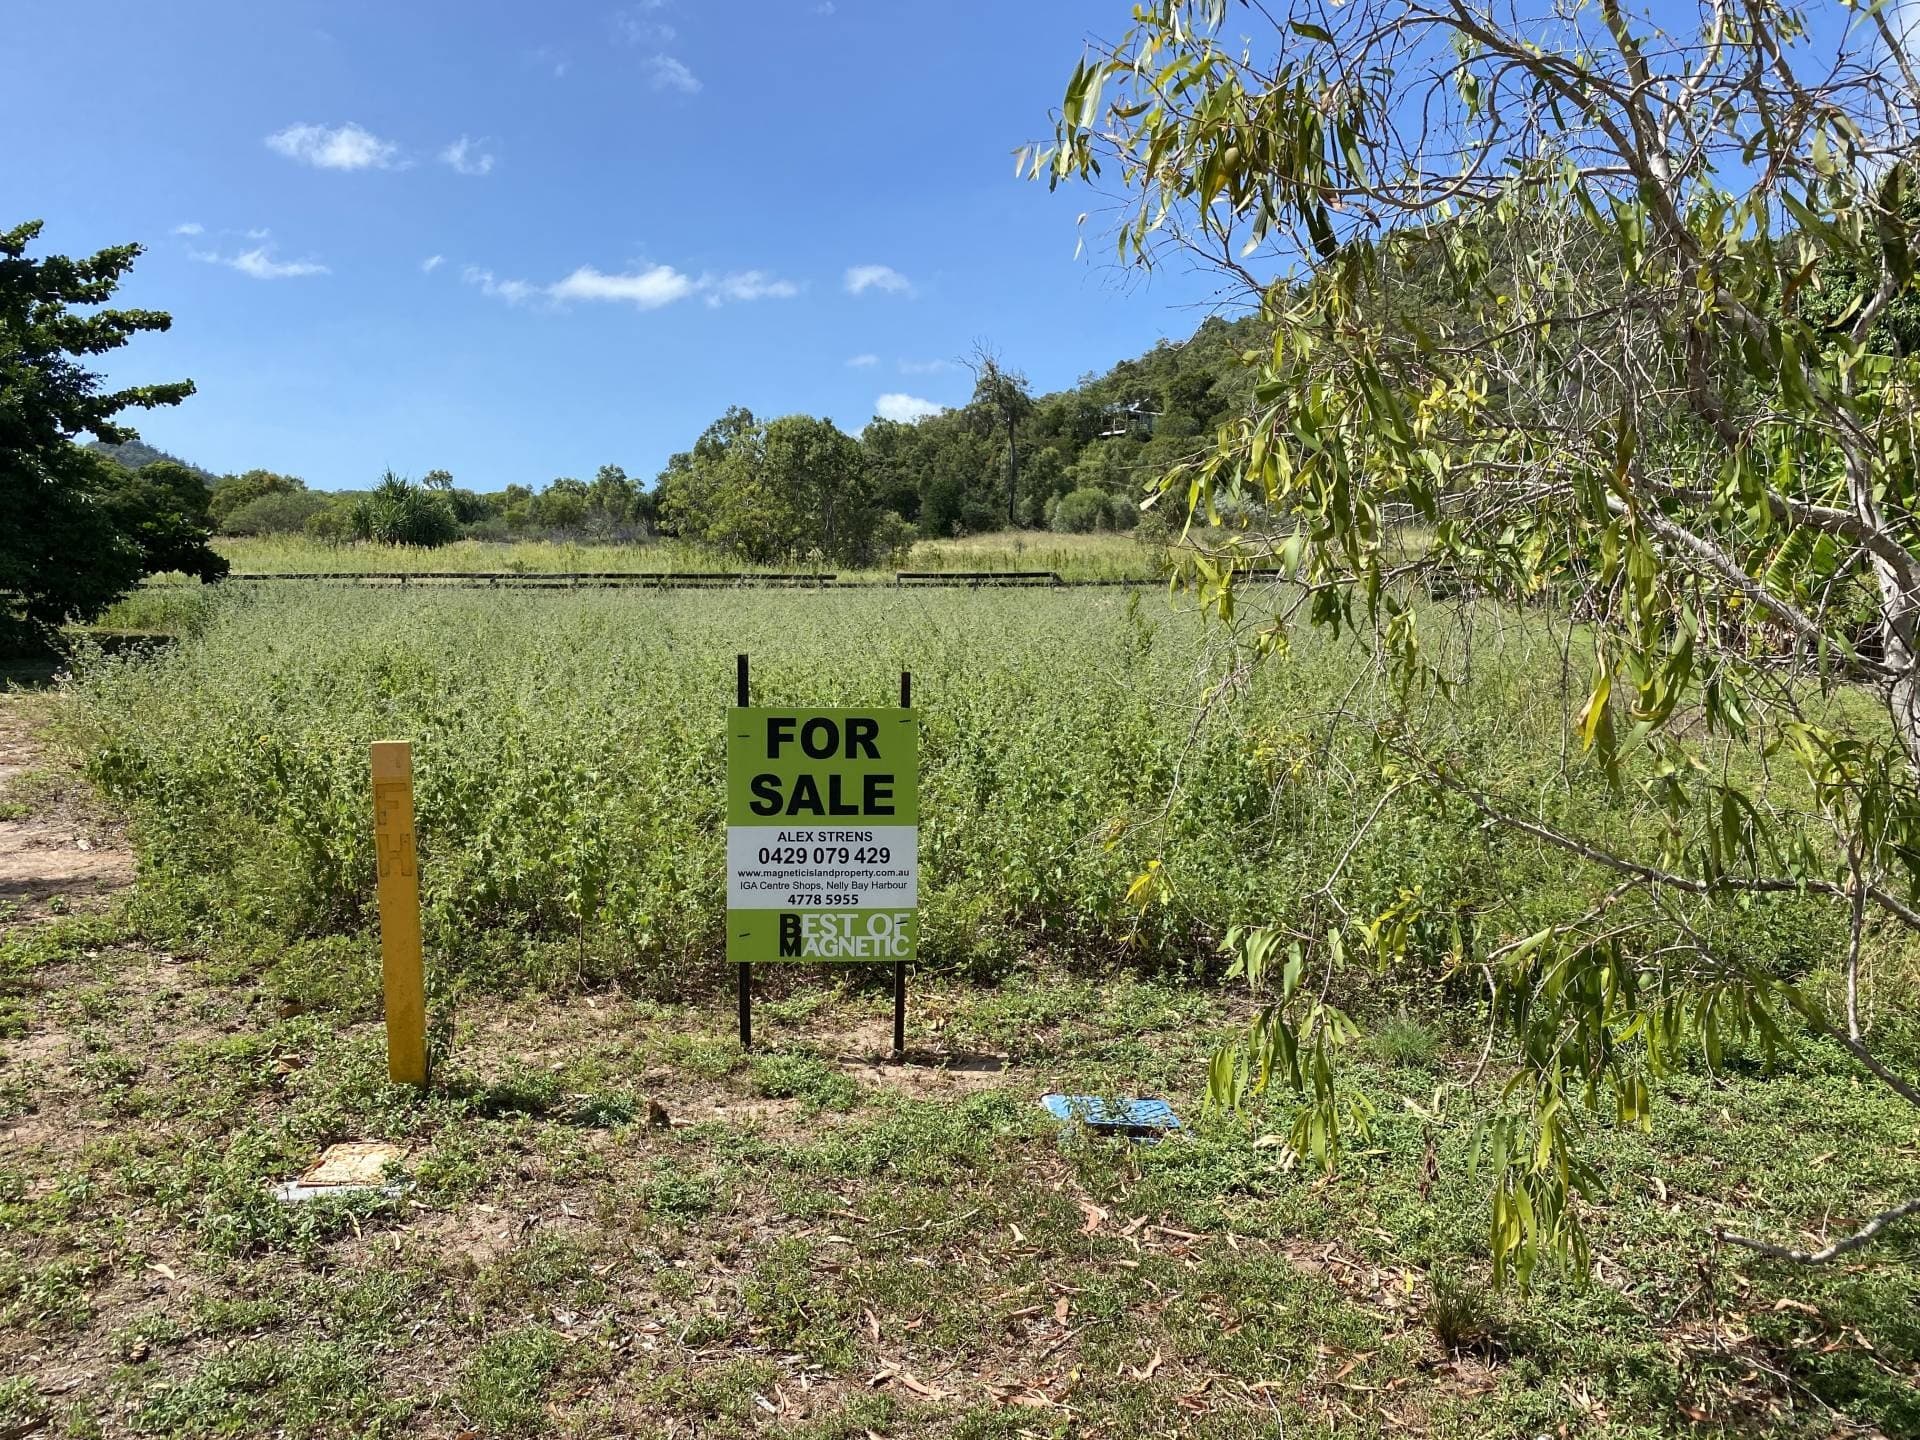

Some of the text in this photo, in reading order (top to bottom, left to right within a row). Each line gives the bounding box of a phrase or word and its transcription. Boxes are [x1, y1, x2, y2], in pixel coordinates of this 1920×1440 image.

[766, 717, 882, 760] FOR
[749, 773, 895, 817] SALE
[777, 831, 873, 842] ALEX STRENS
[758, 847, 891, 864] 0429 079 429
[737, 868, 910, 878] www.magneticislandproperty.com.au
[740, 881, 907, 892] IGA Centre Shops, Nelly Bay Harbour
[787, 894, 859, 905] 4778 5955
[779, 912, 911, 938] BEST OF
[779, 935, 910, 958] MAGNETIC
